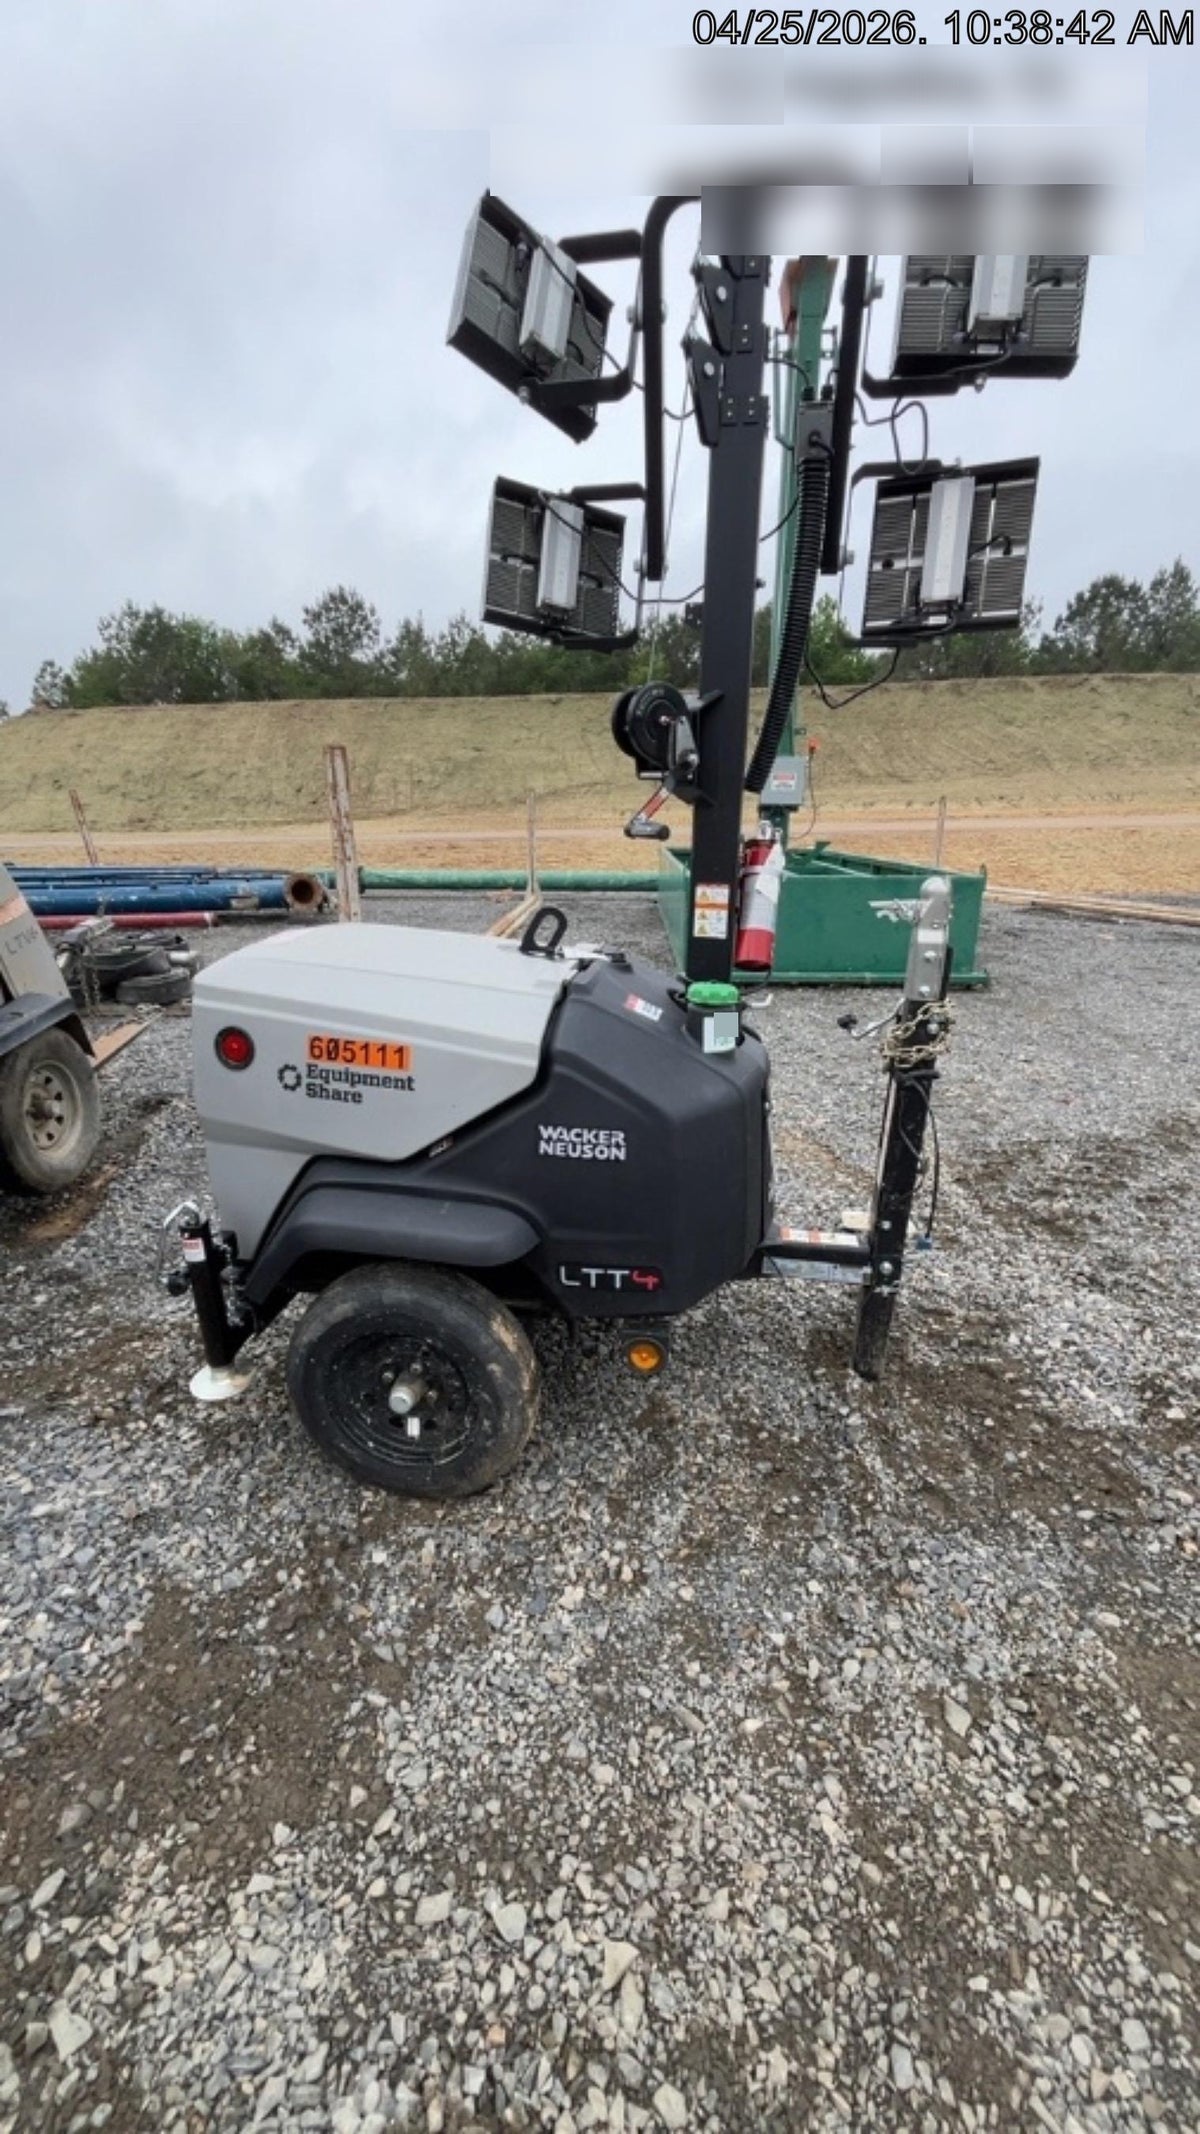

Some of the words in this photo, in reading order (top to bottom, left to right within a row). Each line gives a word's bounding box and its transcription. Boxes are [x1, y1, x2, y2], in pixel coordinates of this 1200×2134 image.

[309, 1035, 405, 1070] 605111
[305, 1063, 415, 1092] Equipment
[305, 1082, 363, 1103] Share
[538, 1124, 626, 1146] WACKER
[538, 1140, 627, 1161] NEUSON
[559, 1265, 660, 1291] LTT4
